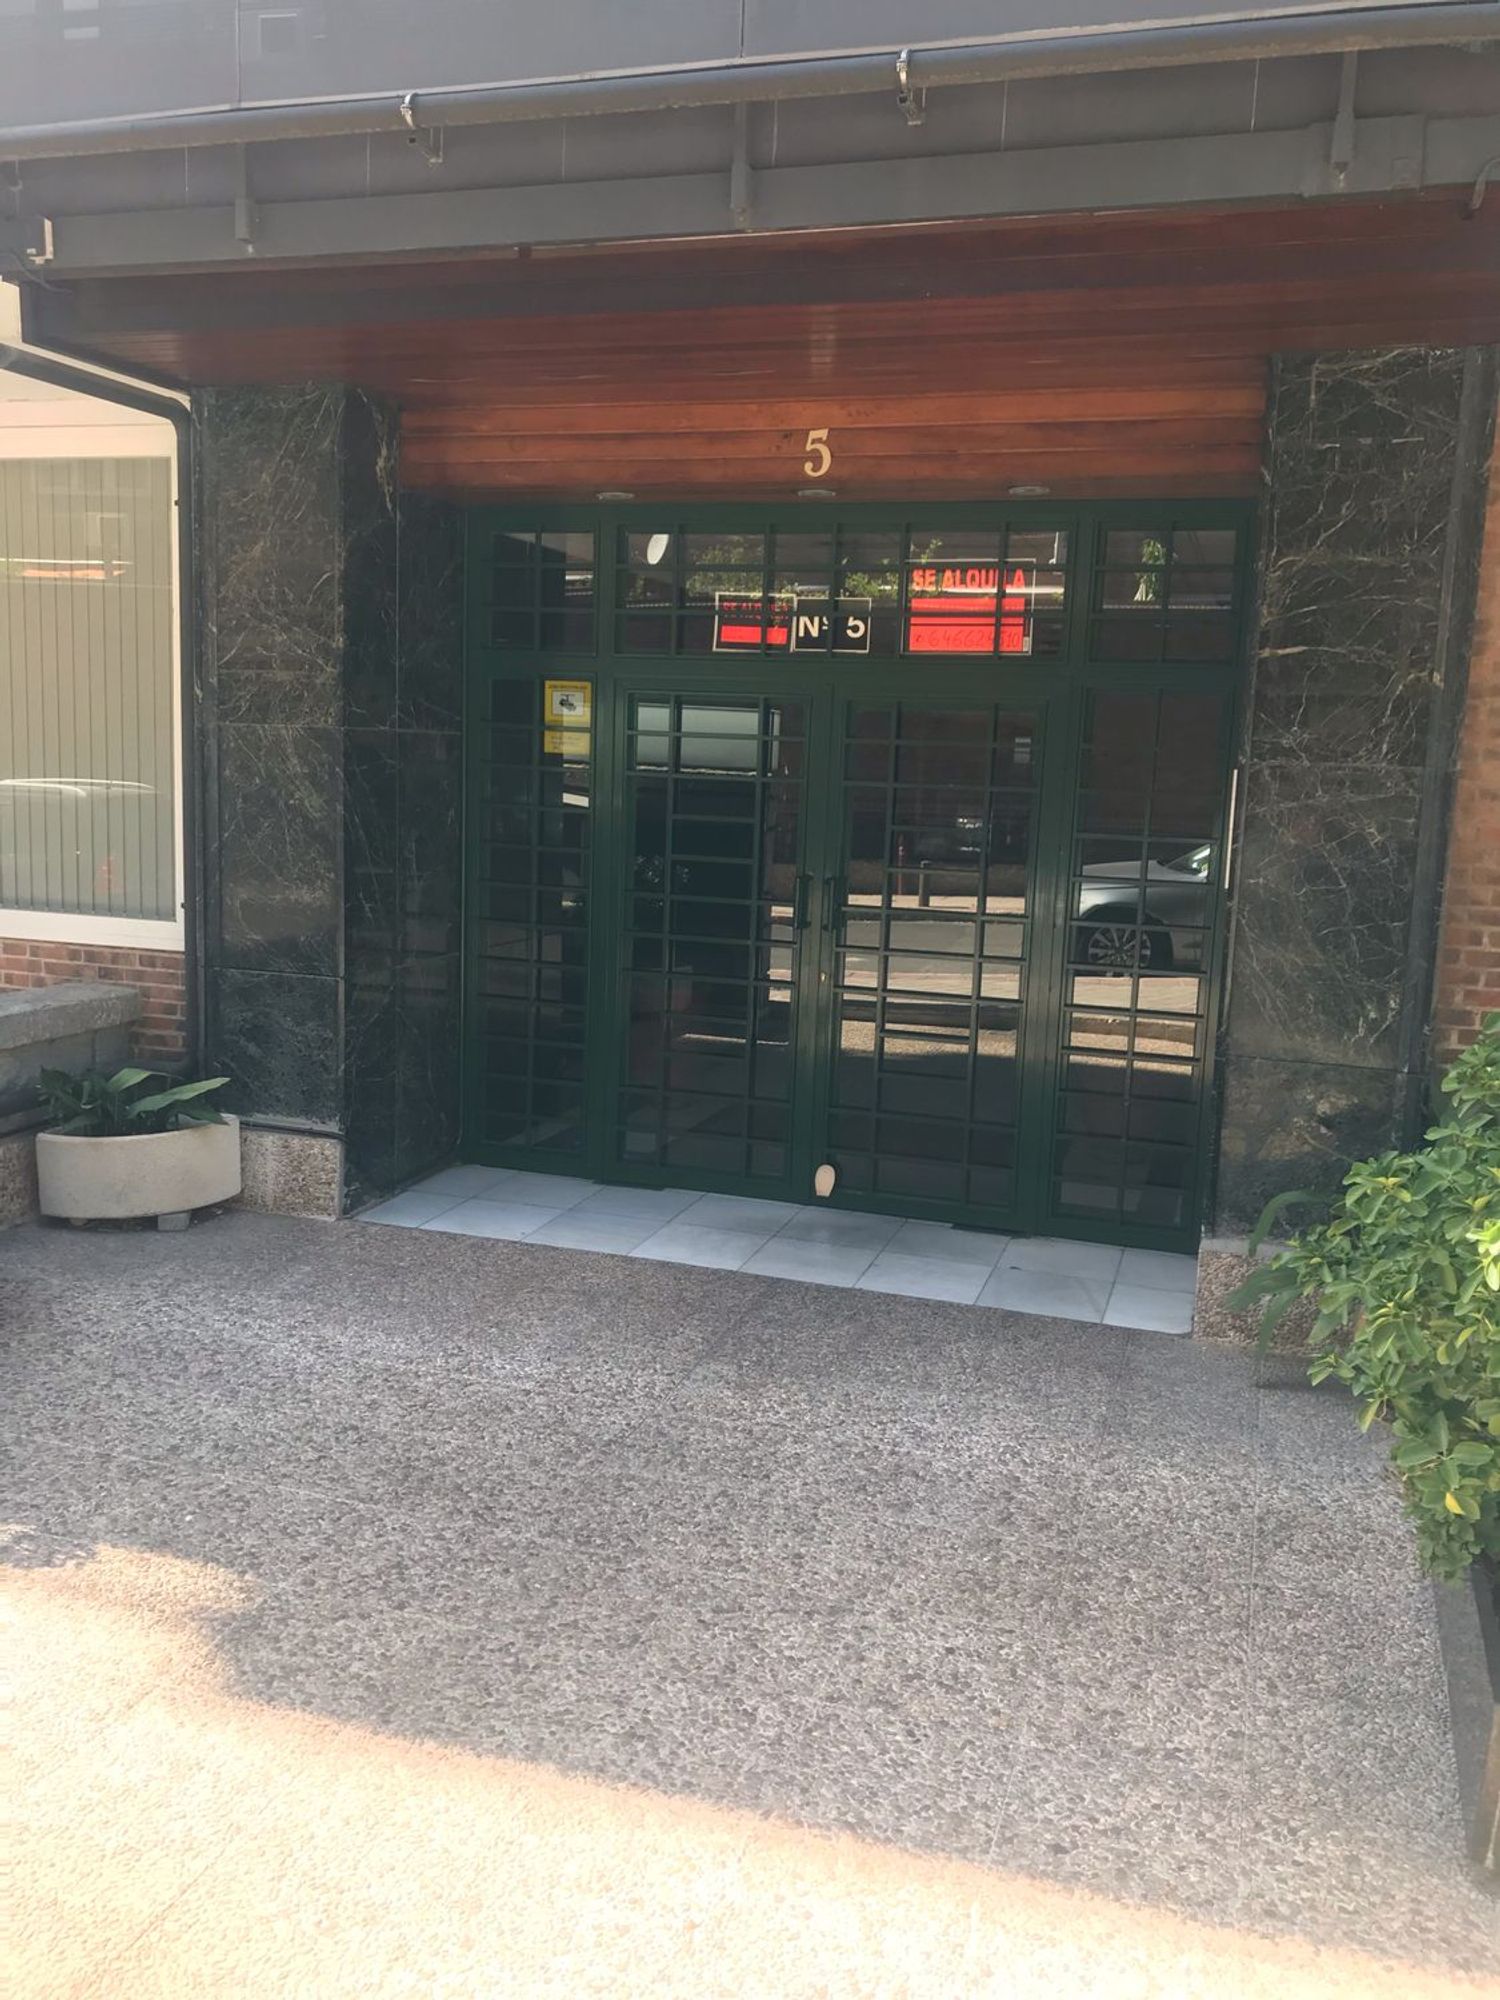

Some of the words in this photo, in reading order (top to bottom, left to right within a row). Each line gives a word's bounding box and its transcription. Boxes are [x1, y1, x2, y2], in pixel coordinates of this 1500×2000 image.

[803, 428, 832, 478] 5
[912, 568, 937, 591] SE
[846, 615, 866, 639] 5
